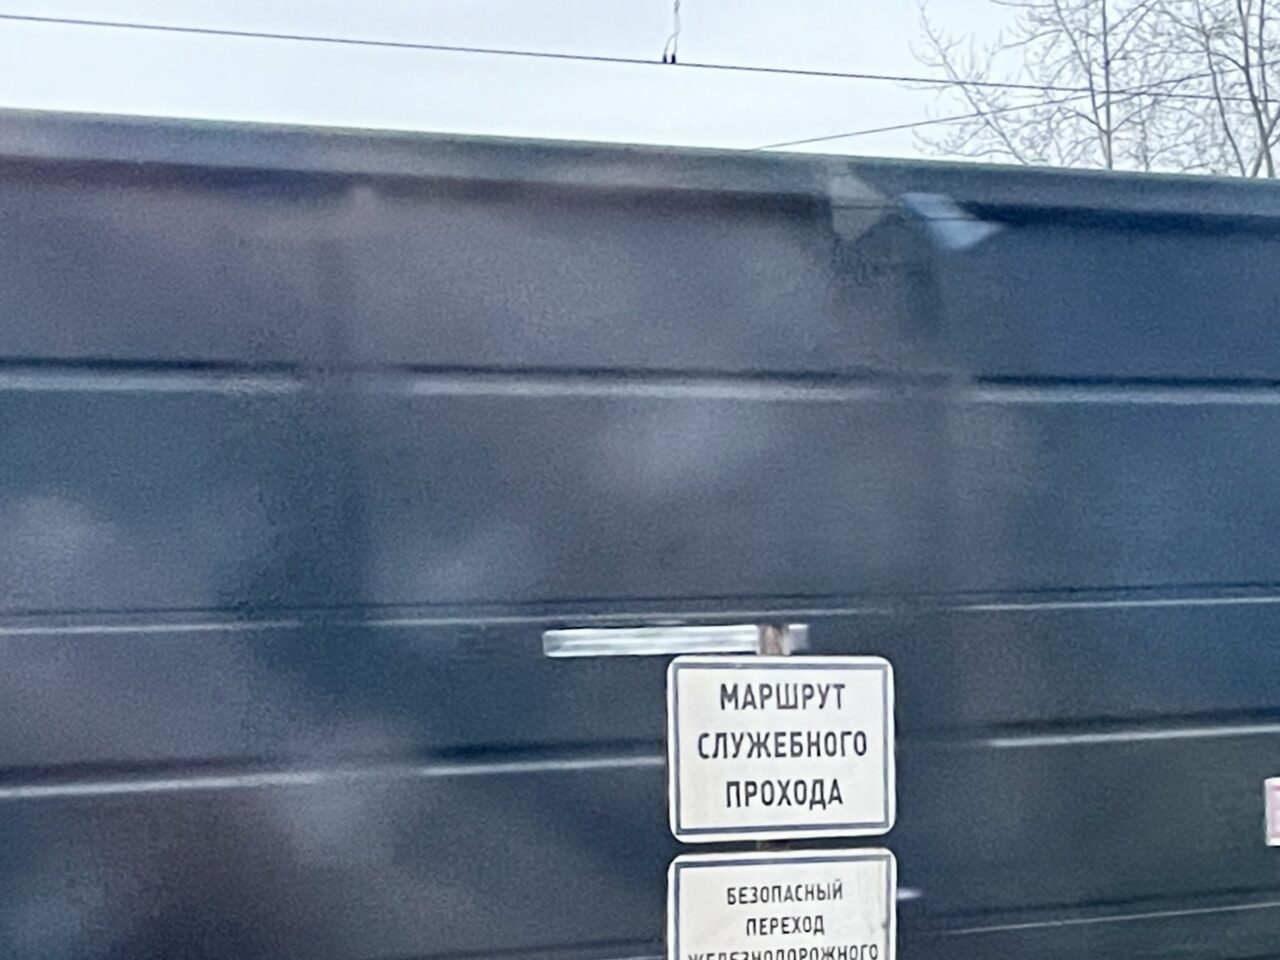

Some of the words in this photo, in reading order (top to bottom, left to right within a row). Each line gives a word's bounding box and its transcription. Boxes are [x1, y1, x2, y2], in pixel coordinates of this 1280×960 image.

[720, 682, 846, 711] МАРШРУТ
[698, 730, 868, 759] СЛУЖЕБНОГО
[726, 778, 844, 810] ПРОХОДА
[726, 879, 844, 905] БЕЗОПАСНЫЙ
[746, 915, 826, 936] ПЕРЕХОД
